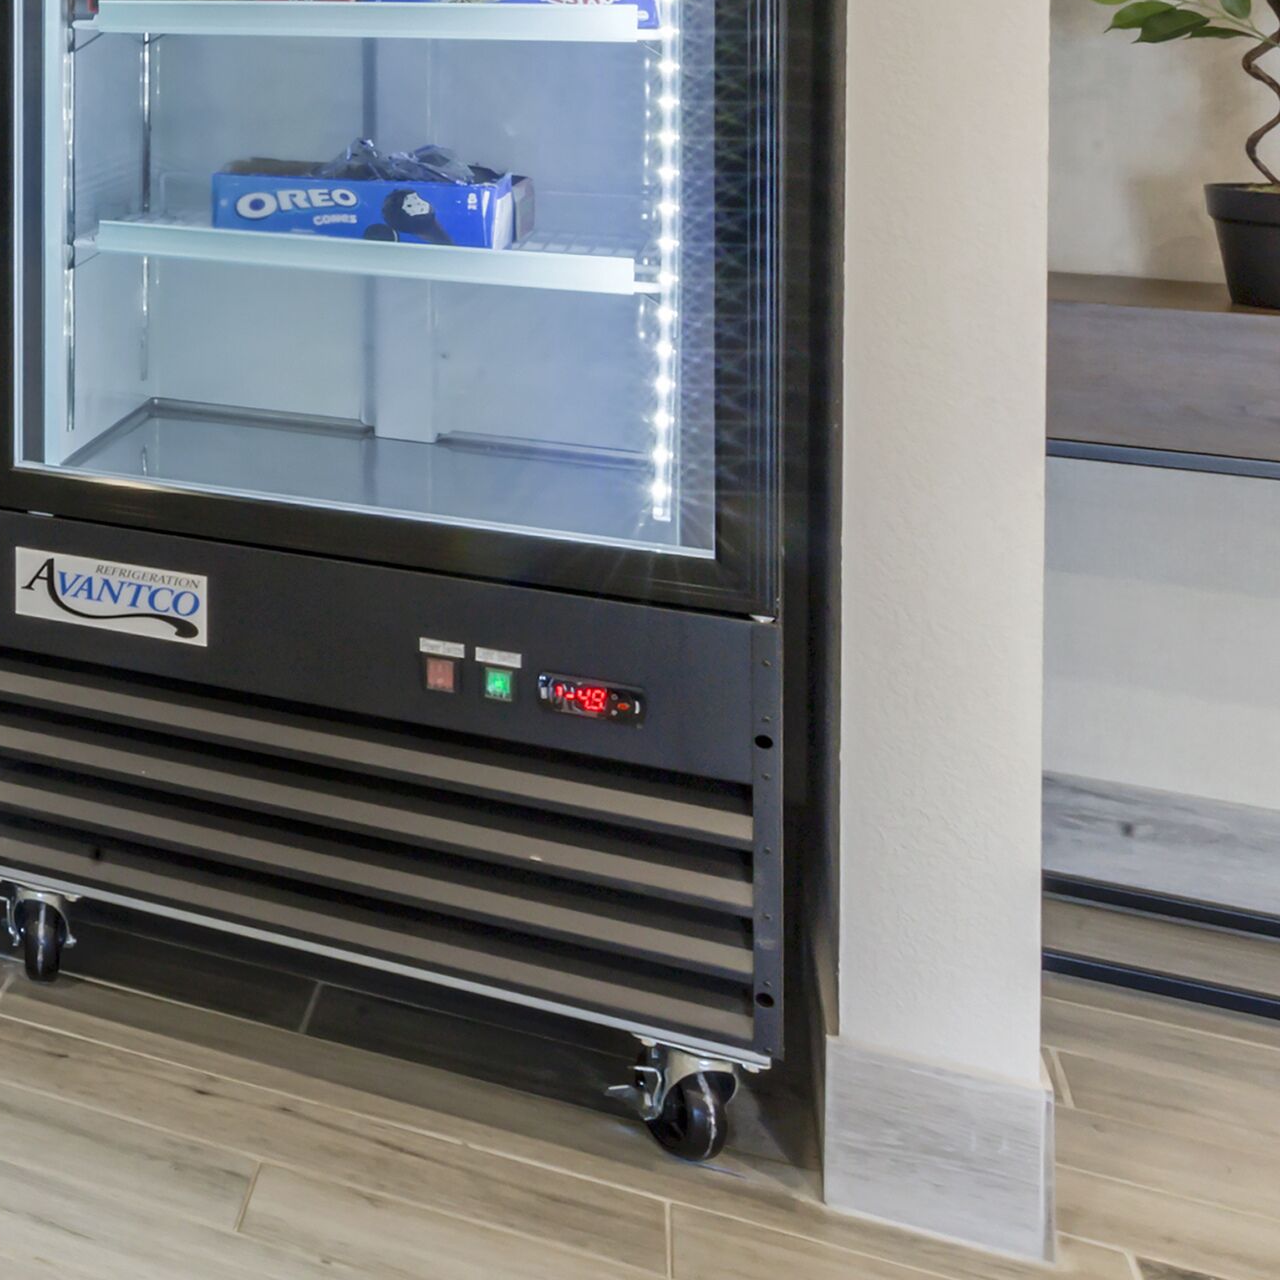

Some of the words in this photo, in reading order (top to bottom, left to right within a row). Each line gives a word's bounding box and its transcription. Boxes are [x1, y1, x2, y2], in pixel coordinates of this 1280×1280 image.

[235, 188, 358, 219] OREO
[313, 213, 357, 226] CONES
[21, 558, 201, 619] AVANTCO
[95, 564, 202, 589] REFRIGERATION
